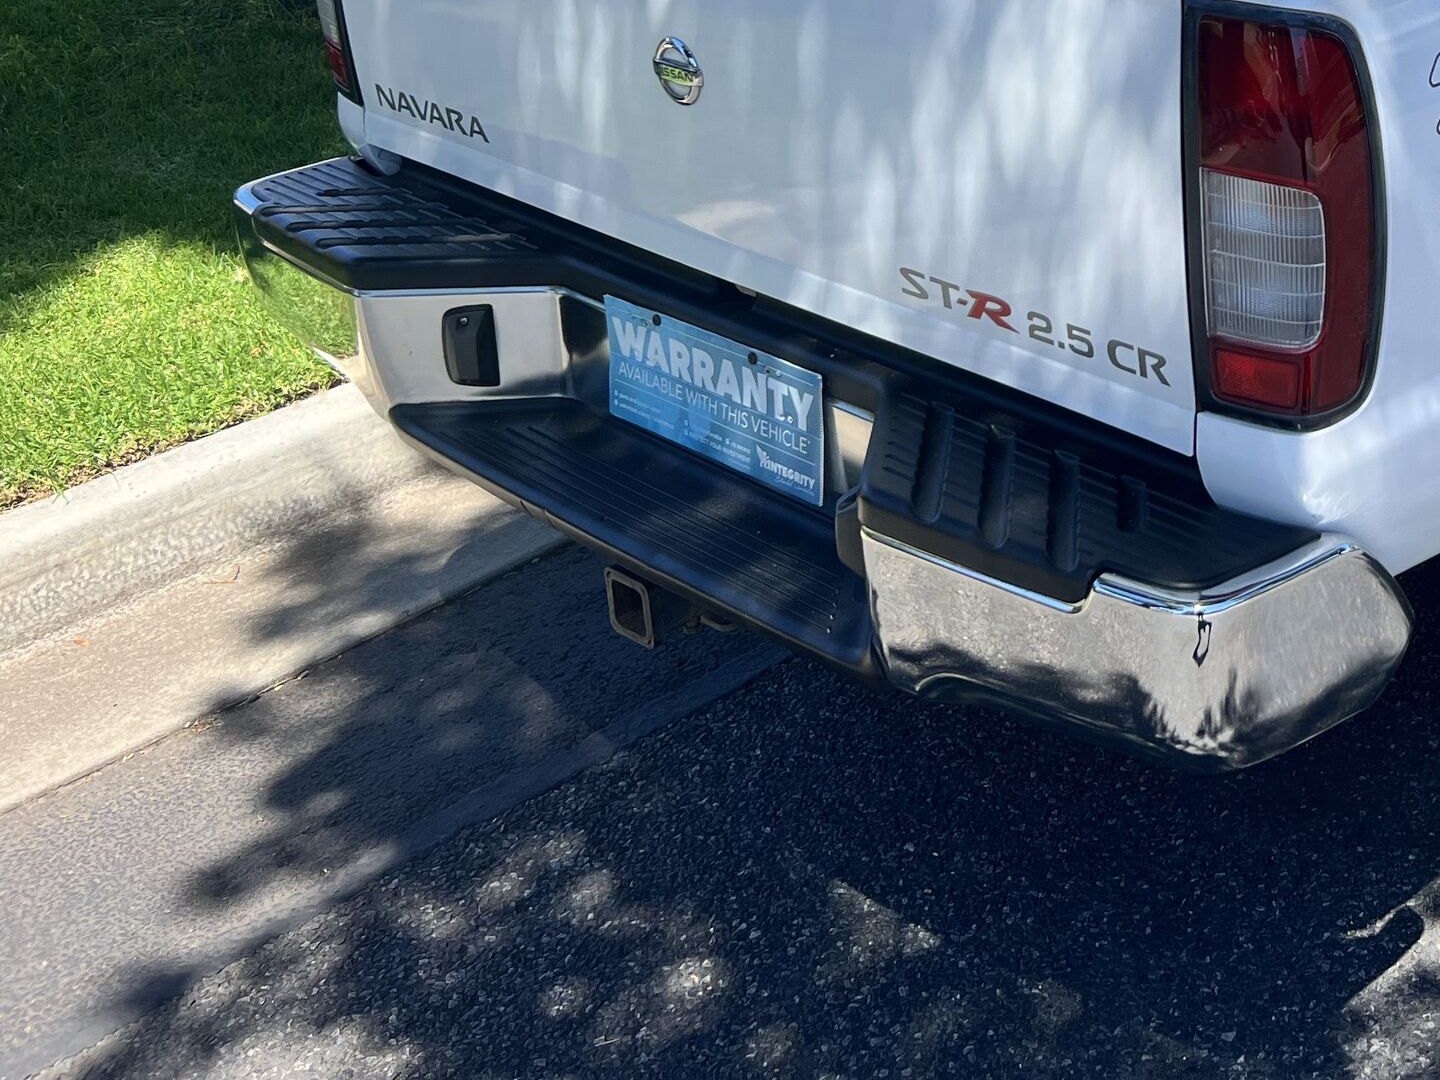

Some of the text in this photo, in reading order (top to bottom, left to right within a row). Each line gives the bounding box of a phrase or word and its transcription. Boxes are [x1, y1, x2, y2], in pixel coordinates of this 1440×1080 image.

[374, 82, 490, 144] NAVARA
[899, 266, 1172, 388] ST-R 2.5 CR
[611, 316, 814, 432] WARRANTY
[618, 362, 683, 401] AVAILABLE
[685, 387, 718, 416] WITH
[720, 402, 749, 429] THIS
[766, 457, 816, 490] INTEGRITY
